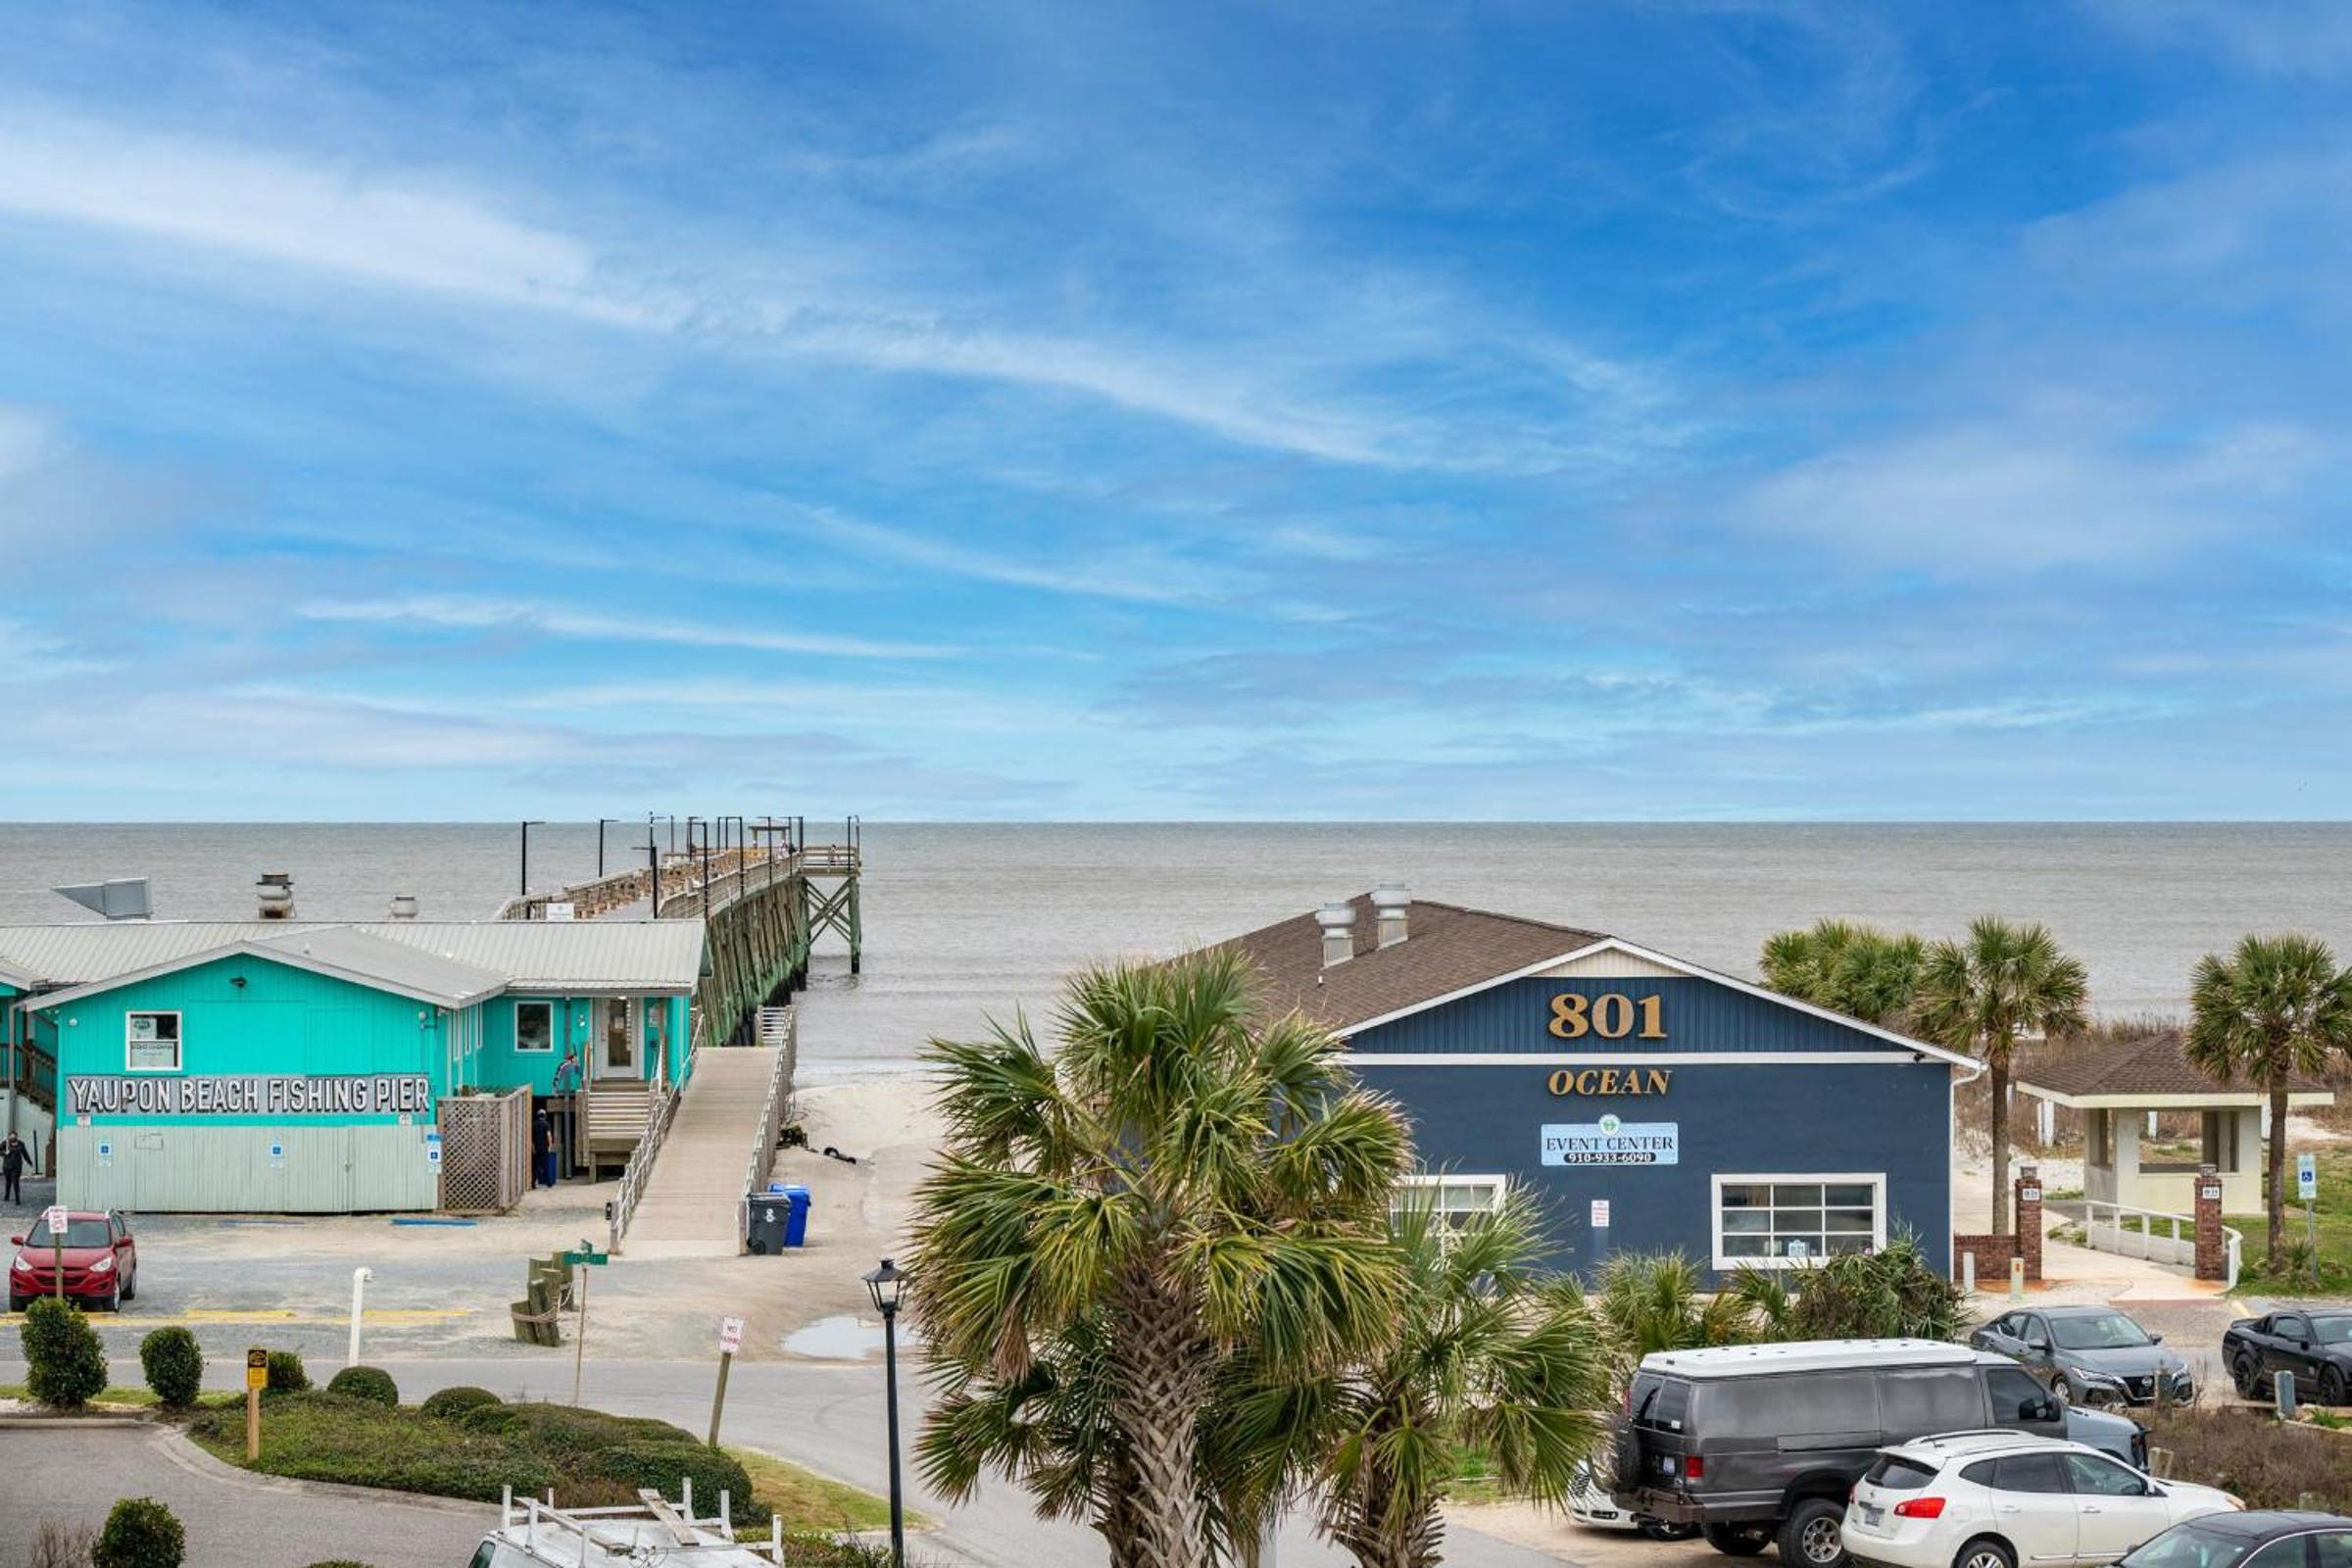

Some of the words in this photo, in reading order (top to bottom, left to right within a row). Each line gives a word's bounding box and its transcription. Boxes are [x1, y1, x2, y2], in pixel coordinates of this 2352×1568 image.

[1548, 993, 1668, 1039] 801
[69, 1079, 171, 1113] YAUPON
[179, 1079, 260, 1113] BEACH
[268, 1079, 368, 1112] FISHING
[374, 1078, 429, 1112] PIER
[1547, 1069, 1673, 1097] OCEAN
[1546, 1138, 1602, 1152] EVENT
[1606, 1137, 1674, 1151] CENTER
[1568, 1152, 1652, 1163] 910-933-6090
